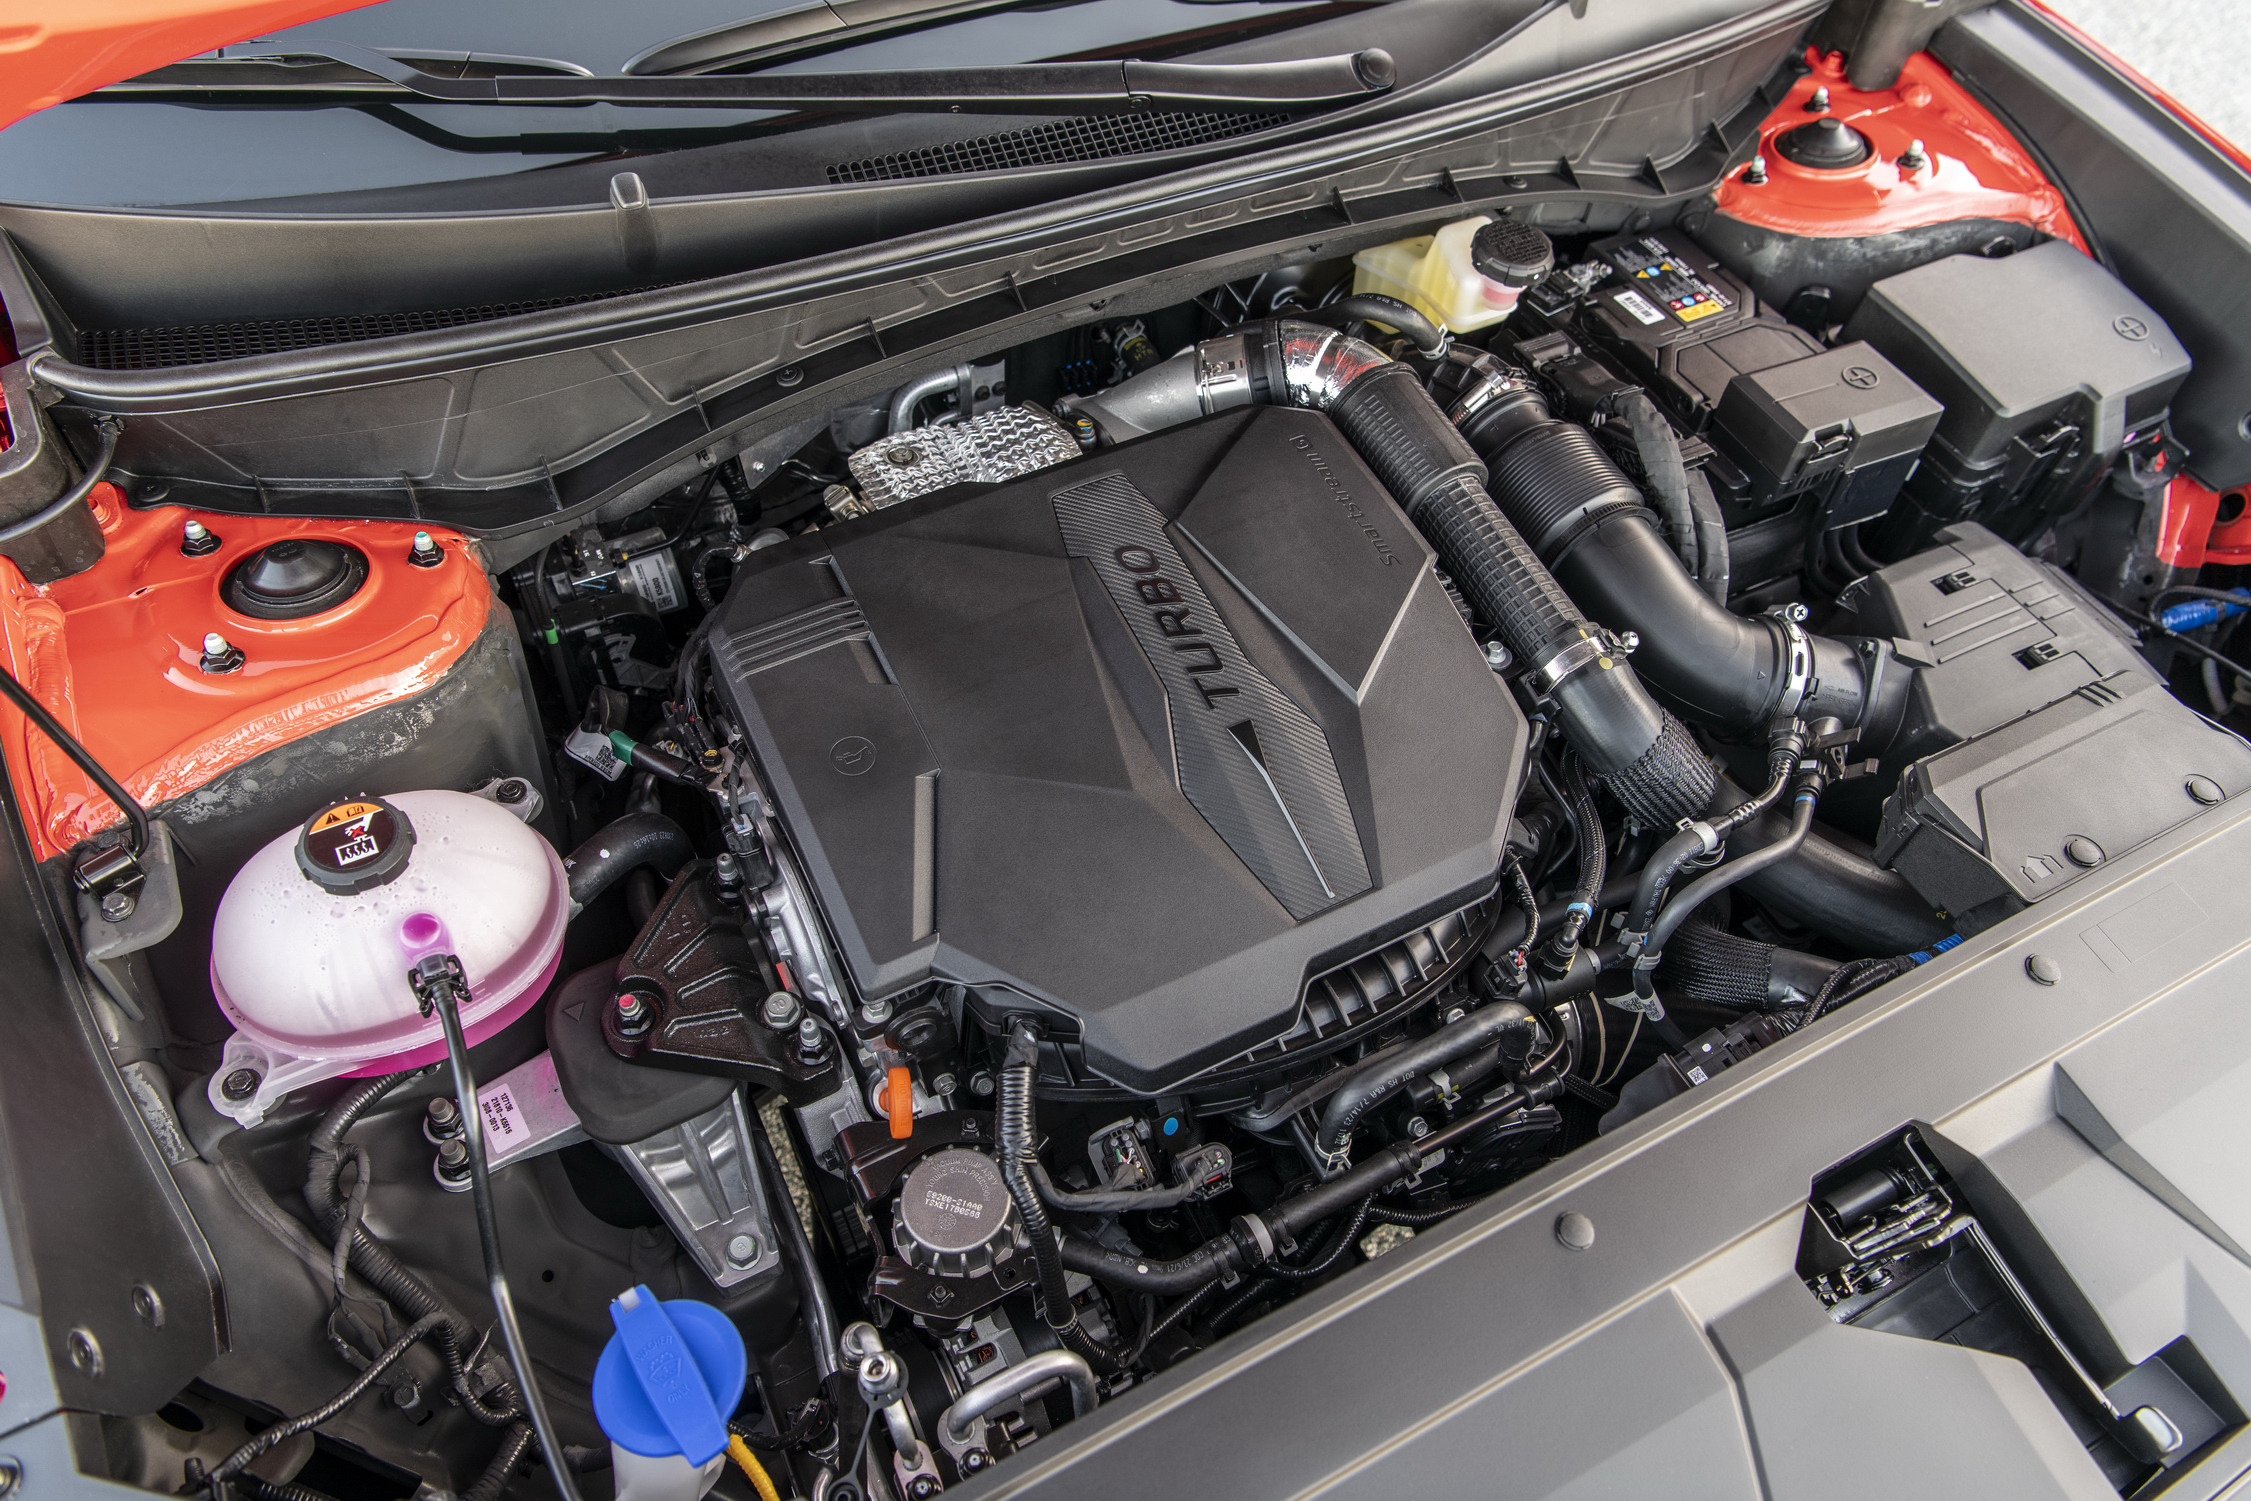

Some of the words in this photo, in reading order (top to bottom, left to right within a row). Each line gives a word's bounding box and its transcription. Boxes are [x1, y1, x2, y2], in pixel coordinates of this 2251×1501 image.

[1306, 452, 1402, 567] Smartstream
[1115, 545, 1241, 711] TURBO
[1387, 1078, 1399, 1088] HS
[1401, 1070, 1416, 1082] DOT
[963, 1158, 983, 1169] PUMP
[635, 1335, 673, 1361] WASHER
[667, 1383, 691, 1404] ONLY
